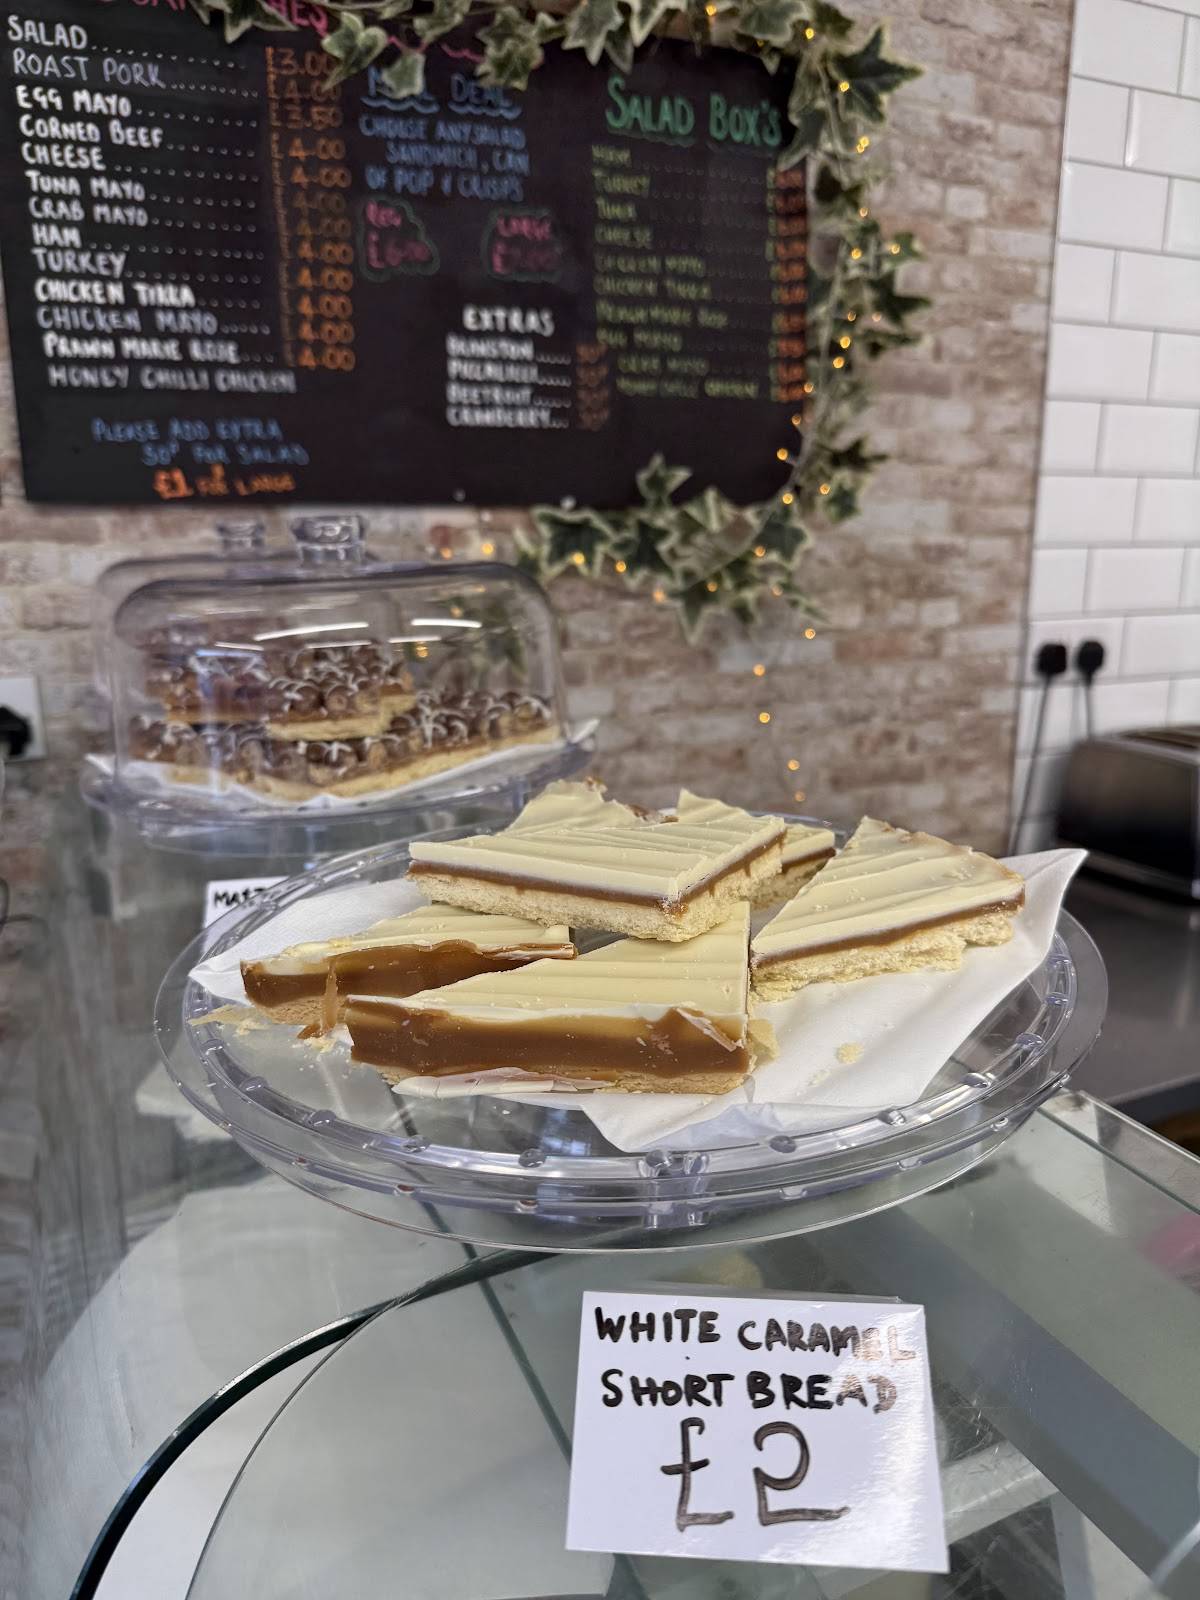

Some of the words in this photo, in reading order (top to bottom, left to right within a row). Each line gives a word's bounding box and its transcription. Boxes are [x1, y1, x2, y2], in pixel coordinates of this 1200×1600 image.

[8, 15, 88, 50] SALAD
[13, 48, 91, 82] ROAST
[103, 57, 166, 89] PORK
[15, 84, 64, 111] EGG
[73, 89, 132, 118] MAYO
[604, 75, 696, 136] SALAD
[19, 114, 101, 143] CORNED
[109, 119, 165, 149] BEEF
[22, 142, 106, 171] CHEESE
[25, 170, 82, 196] TUNA
[90, 175, 146, 202] MAYO
[29, 197, 85, 221] CRAB
[93, 203, 149, 227] MAYO
[31, 223, 82, 249] HAM
[32, 248, 127, 279] TURKEY
[34, 278, 125, 305] CHICKEN
[132, 283, 196, 308] TIKKA
[36, 306, 142, 333] CHICKEN
[154, 312, 218, 336] MAYO
[462, 303, 555, 337] EXTRAS
[48, 364, 130, 390] HONEY
[595, 1306, 721, 1343] WHITE
[737, 1318, 917, 1363] CARAMEL
[601, 1367, 735, 1408] SHORT
[746, 1370, 898, 1415] BREAD
